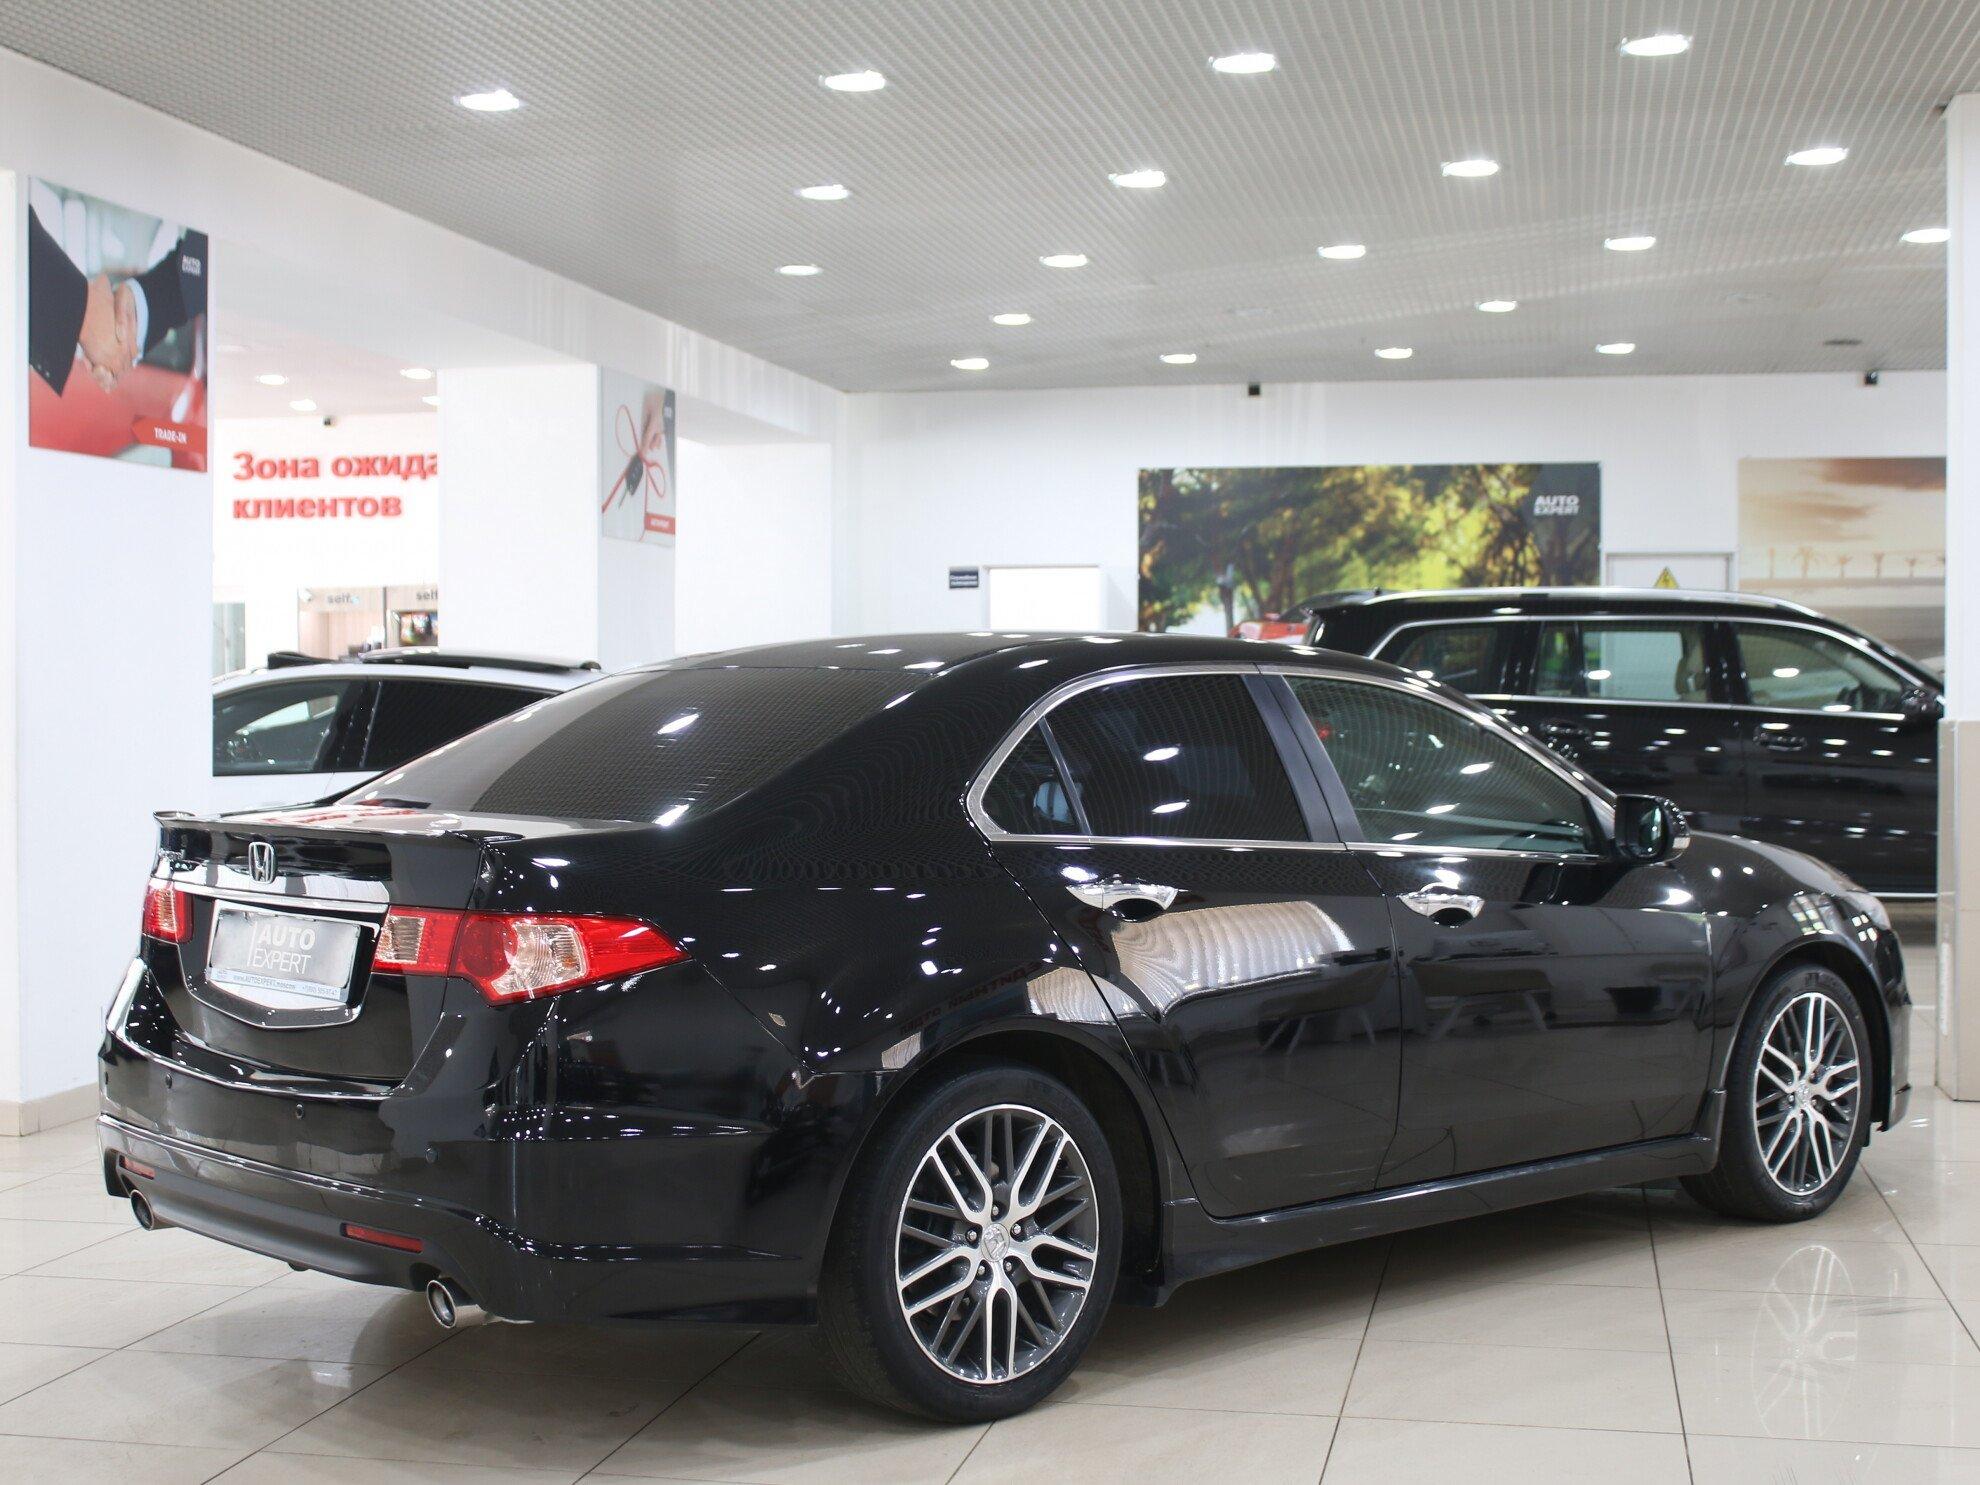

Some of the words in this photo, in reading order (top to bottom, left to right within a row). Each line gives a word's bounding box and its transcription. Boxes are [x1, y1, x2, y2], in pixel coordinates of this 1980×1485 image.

[154, 426, 187, 444] TRADE-IN
[233, 451, 319, 481] Зона
[233, 496, 402, 519] клиентов
[1535, 495, 1580, 506] AUTO
[257, 924, 316, 951] AUTO
[252, 947, 312, 975] EXPERT
